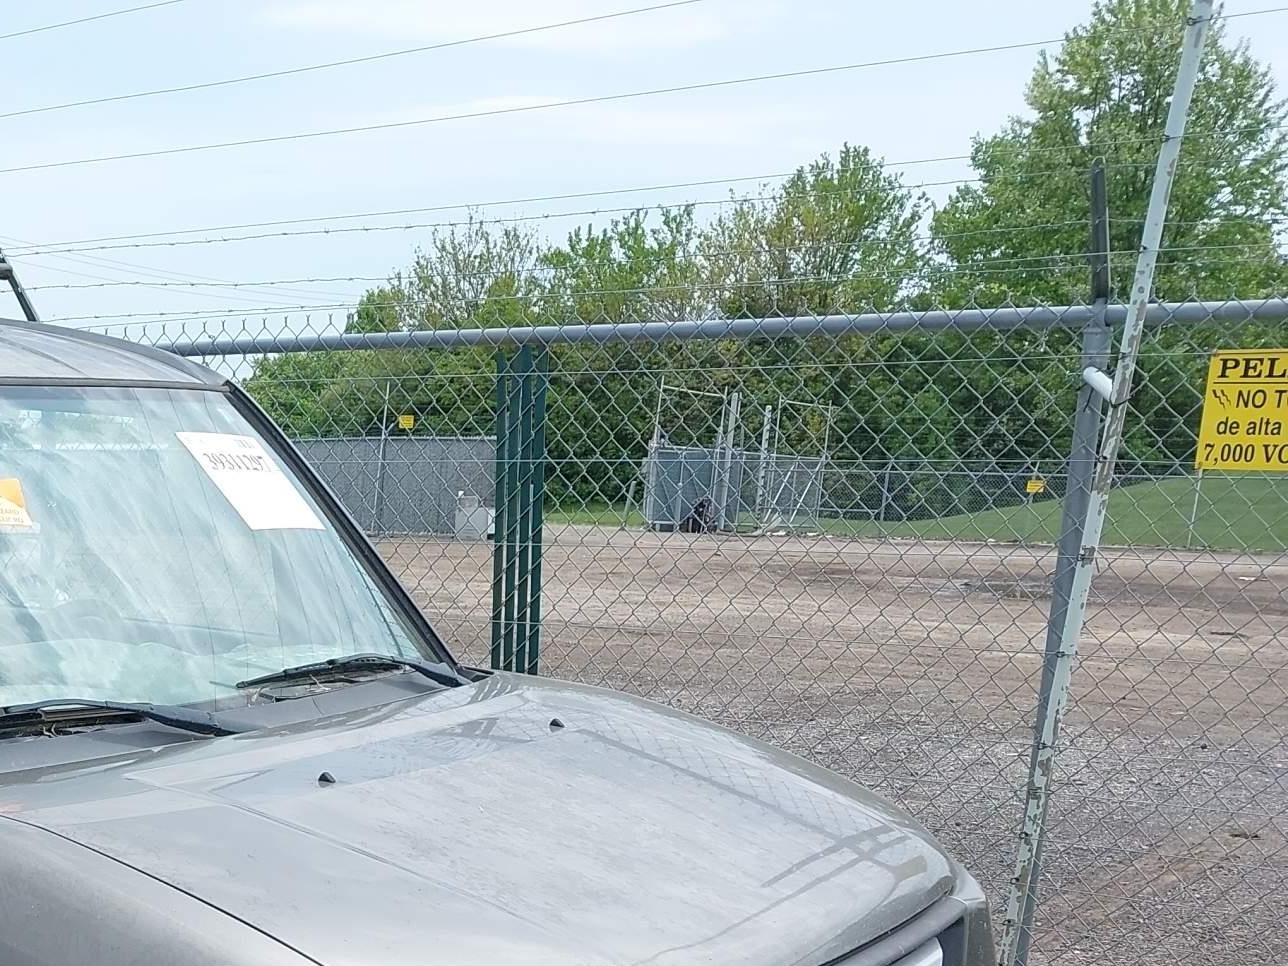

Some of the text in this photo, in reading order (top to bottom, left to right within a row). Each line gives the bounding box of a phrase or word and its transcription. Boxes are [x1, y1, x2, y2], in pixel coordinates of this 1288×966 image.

[1217, 357, 1288, 378] PEL
[1235, 389, 1288, 409] NO T
[1216, 416, 1282, 435] de alta
[202, 453, 265, 471] 39311297
[1204, 442, 1255, 466] 7,000
